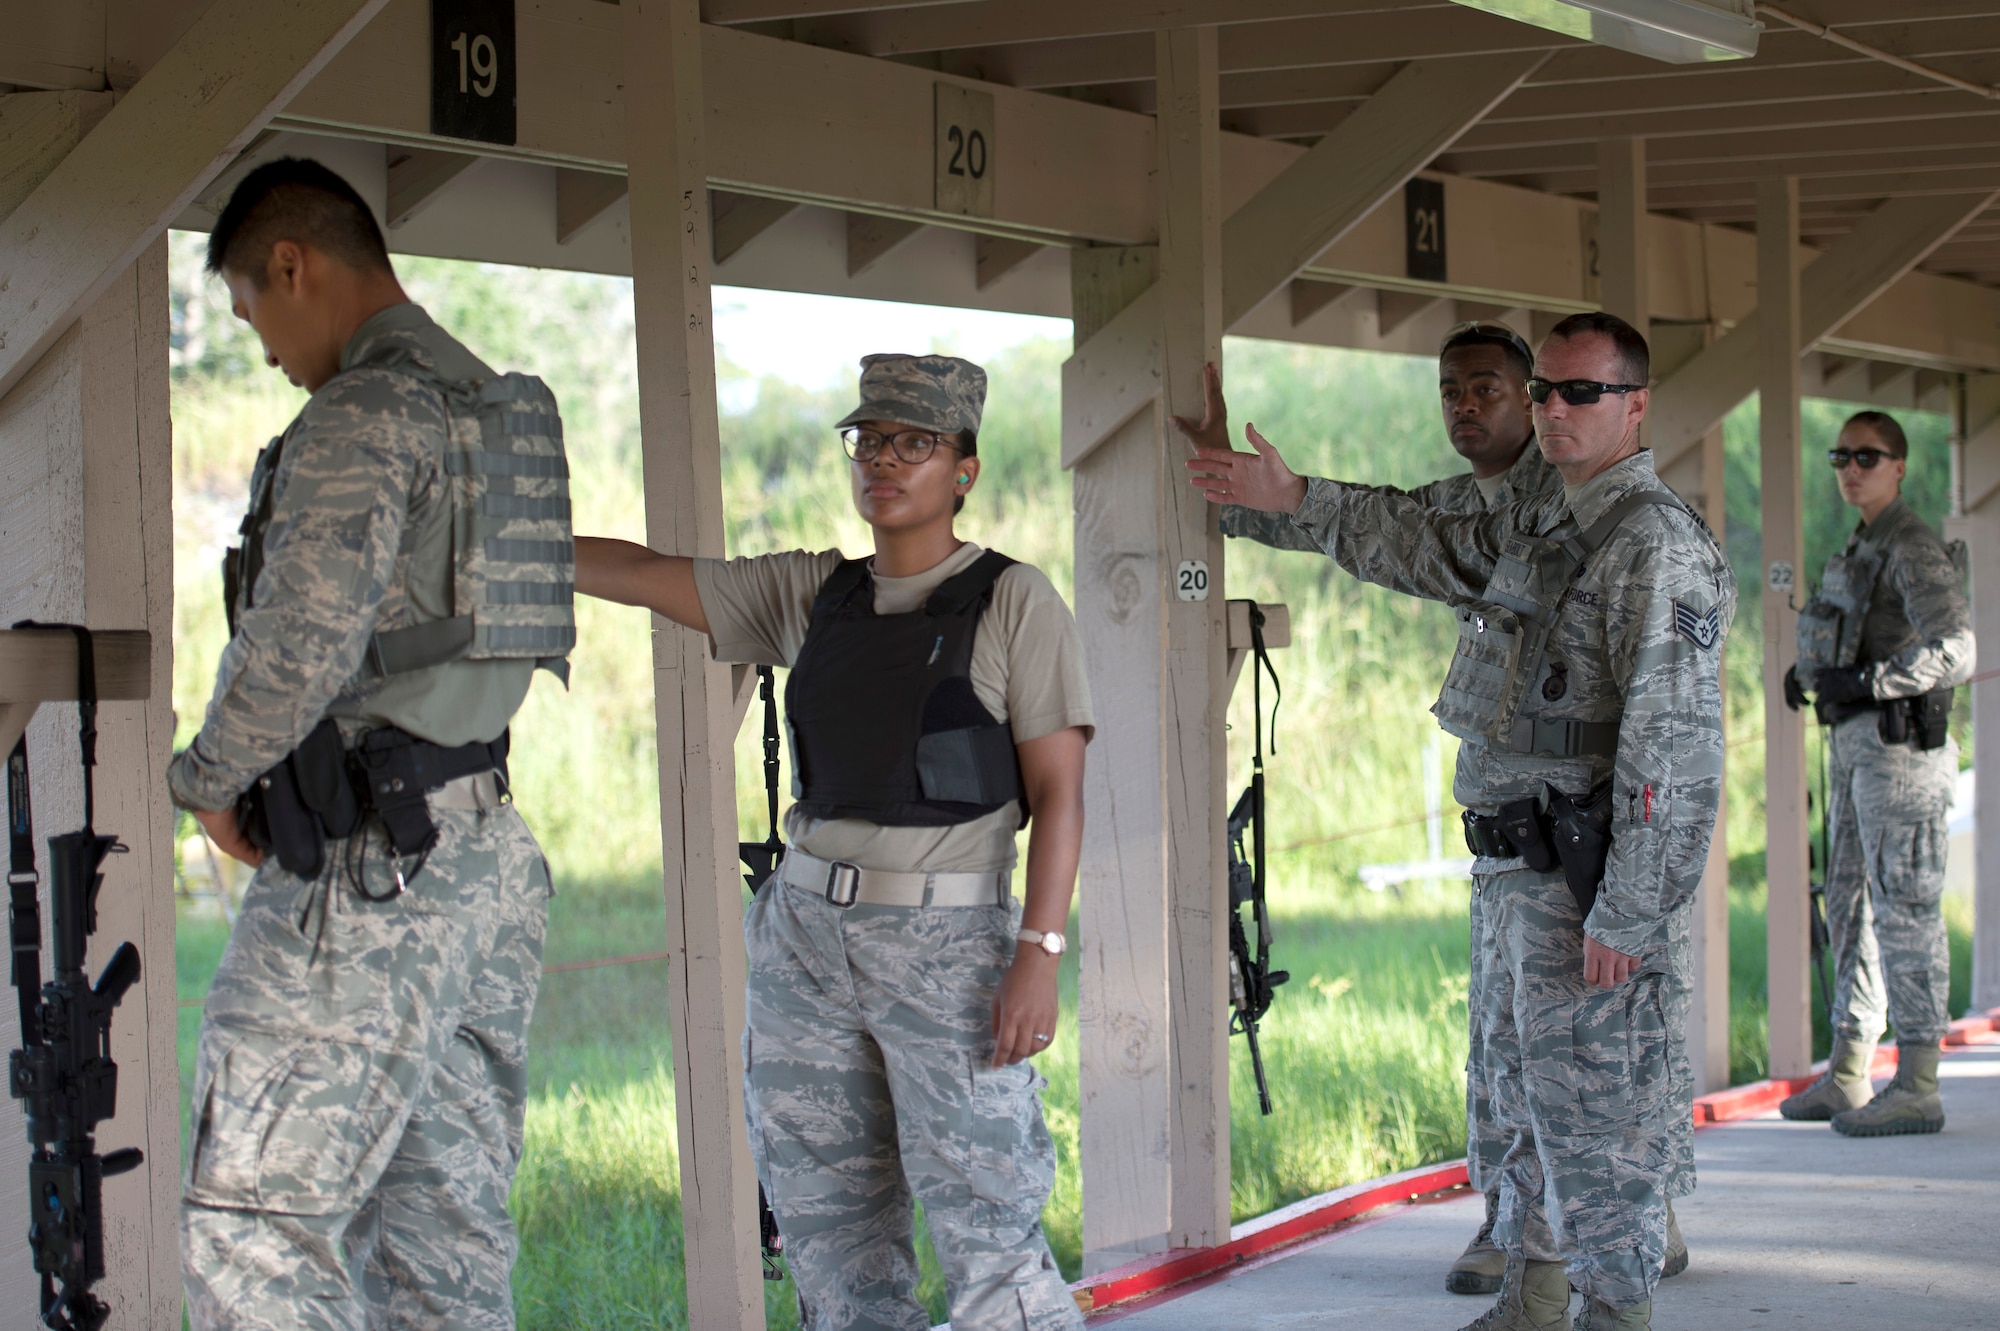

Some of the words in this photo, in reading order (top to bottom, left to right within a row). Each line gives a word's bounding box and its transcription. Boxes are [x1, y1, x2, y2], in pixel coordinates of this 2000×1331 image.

[451, 32, 497, 97] 19
[948, 125, 986, 179] 20
[683, 190, 693, 211] 5
[1415, 208, 1438, 252] 21
[1180, 570, 1207, 590] 20
[1772, 568, 1792, 584] 22
[1568, 587, 1599, 606] FORCE
